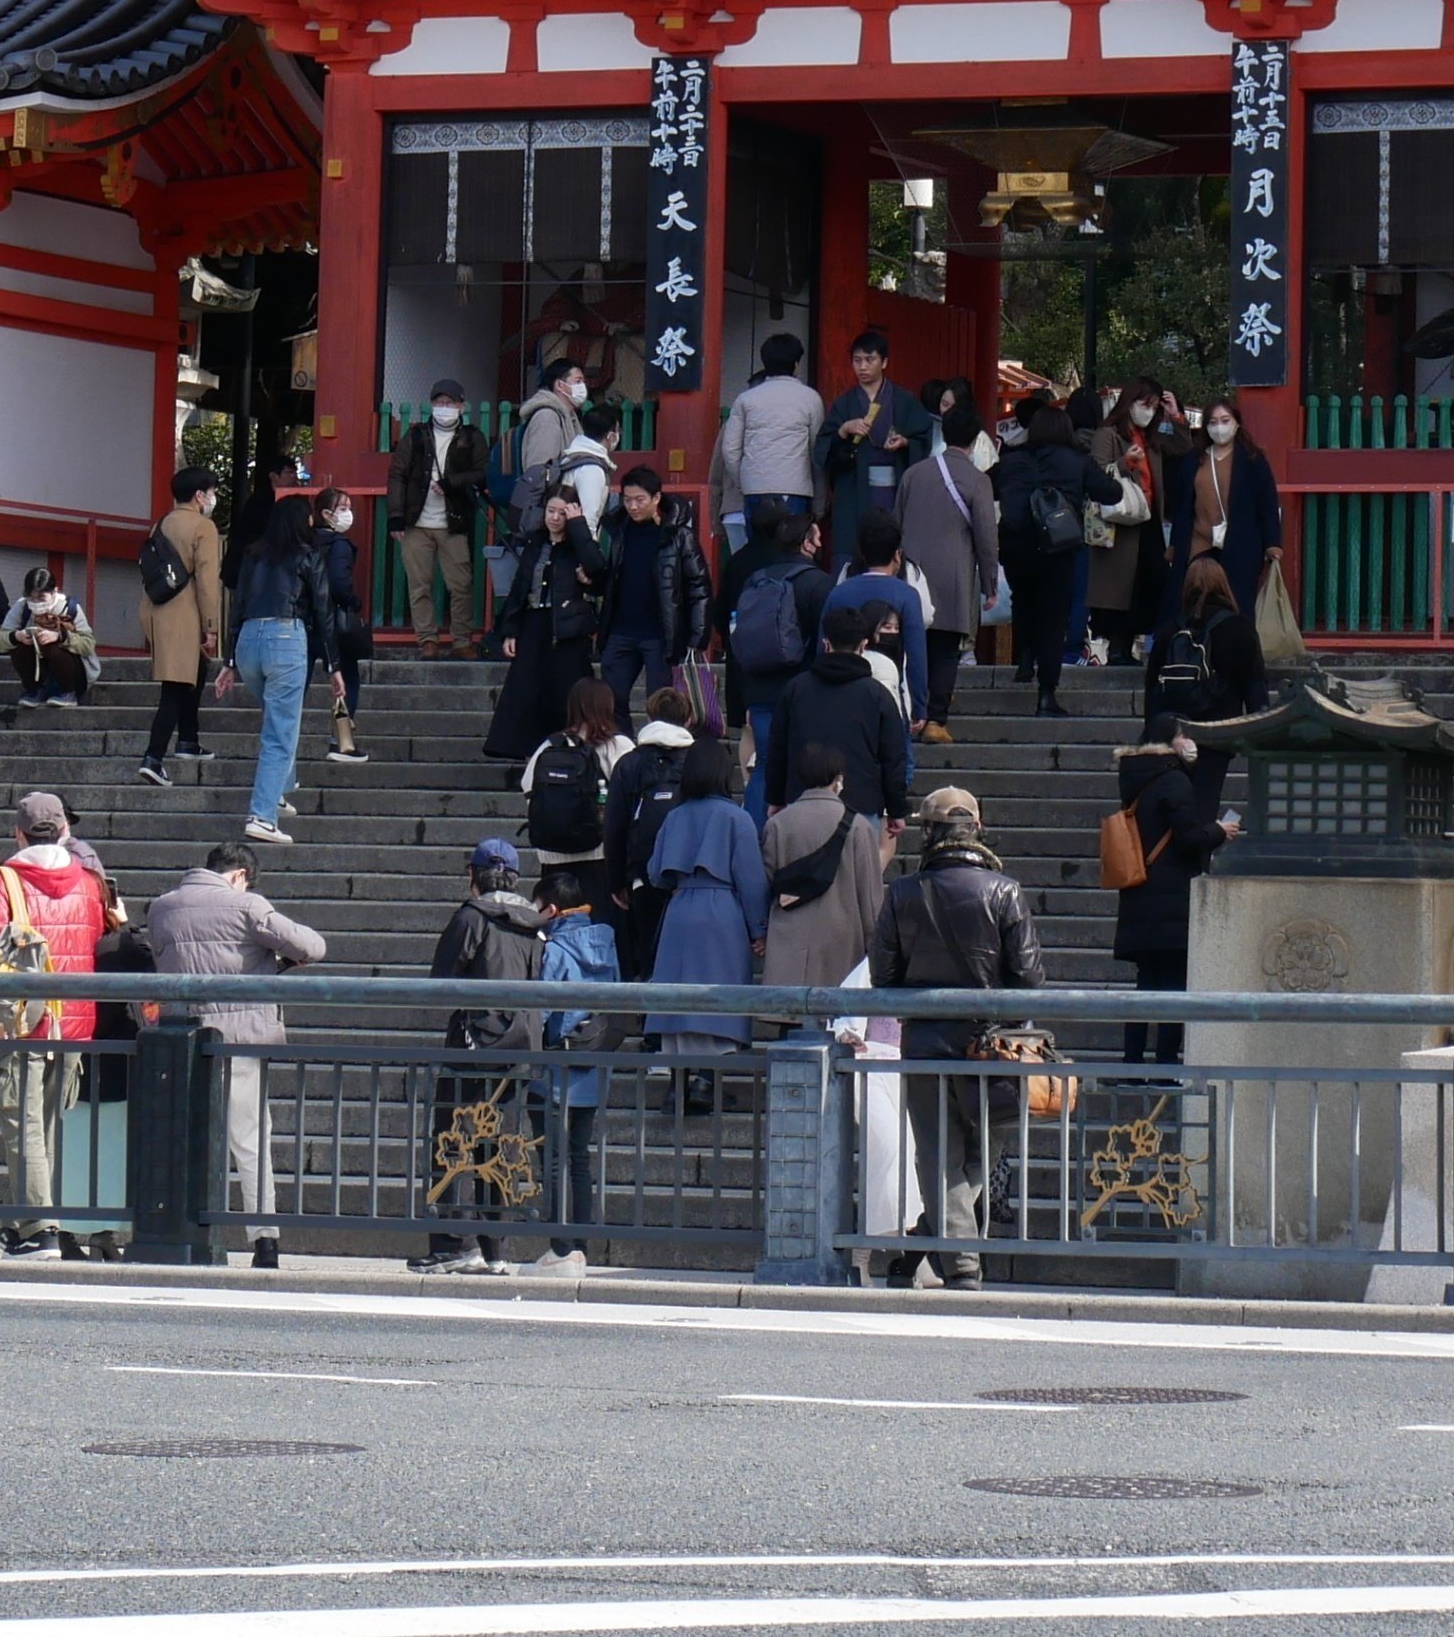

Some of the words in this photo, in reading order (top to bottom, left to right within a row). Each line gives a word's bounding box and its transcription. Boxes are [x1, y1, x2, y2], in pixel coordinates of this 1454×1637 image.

[649, 59, 679, 175] 午前十時
[678, 60, 706, 167] 二月二十三日
[1231, 43, 1261, 155] 午前十時
[1258, 45, 1286, 150] 二月十五日
[650, 190, 699, 378] 天長祭
[1234, 168, 1283, 358] 月次祭
